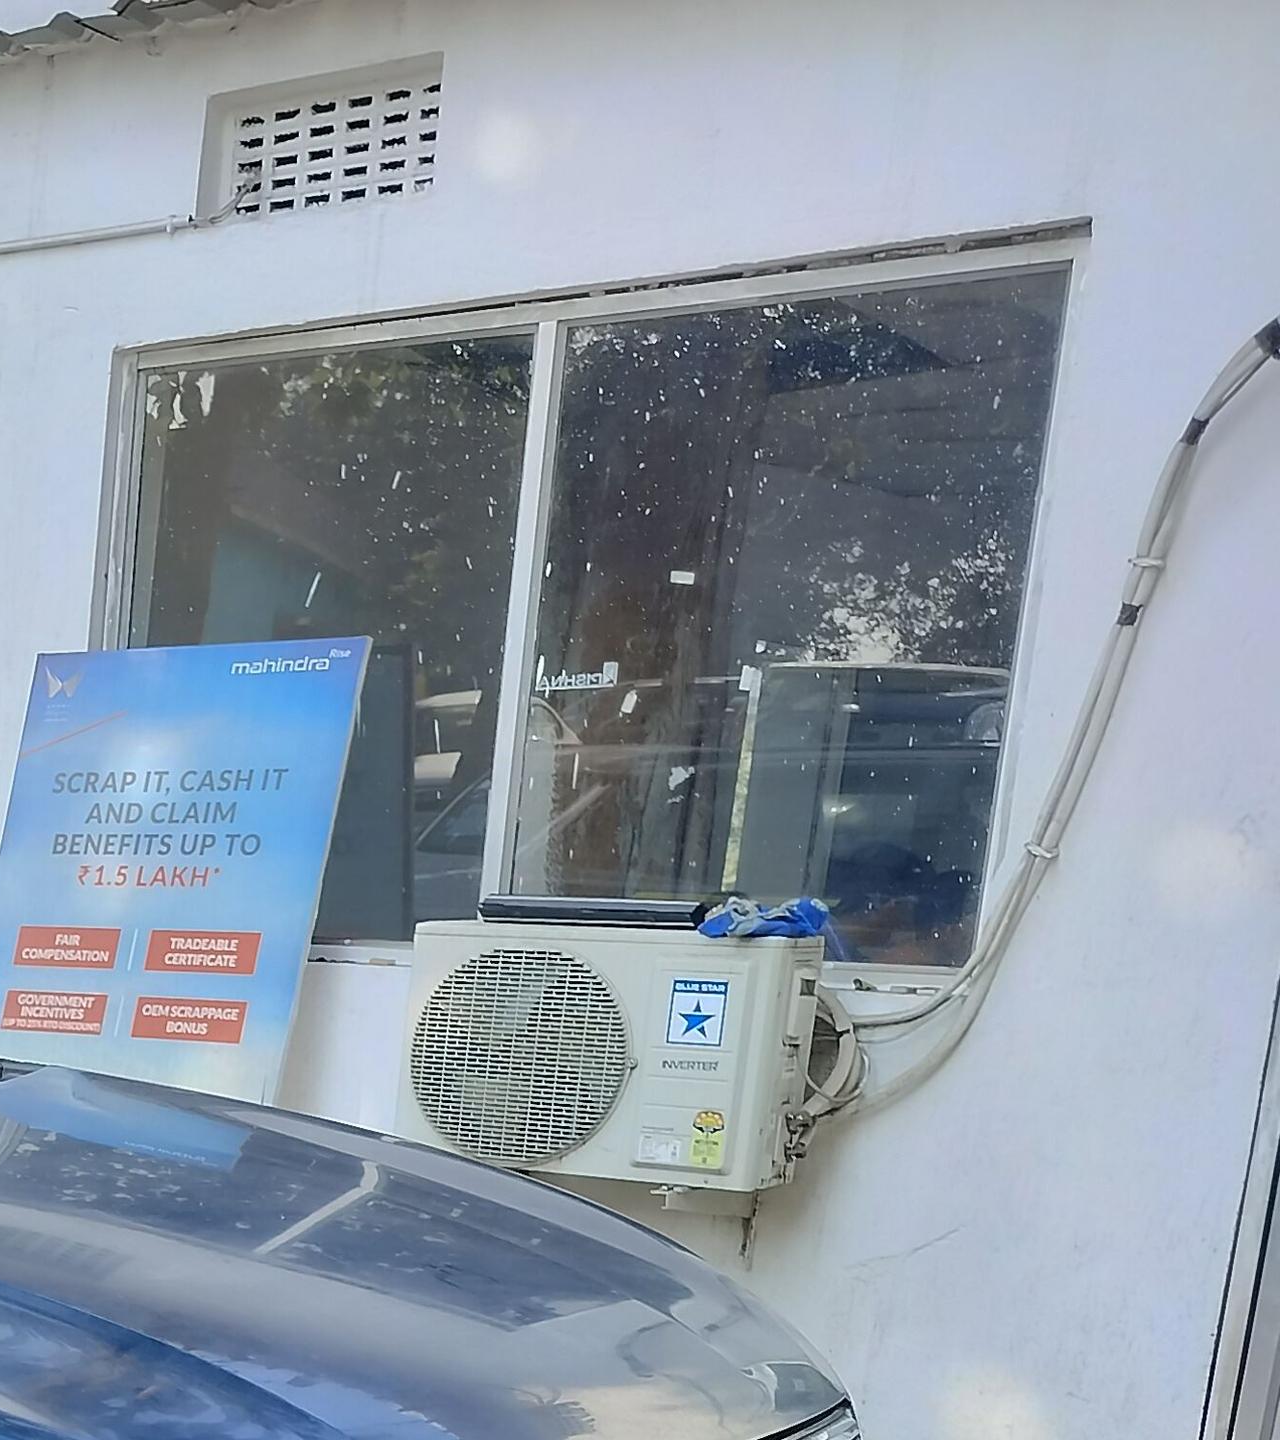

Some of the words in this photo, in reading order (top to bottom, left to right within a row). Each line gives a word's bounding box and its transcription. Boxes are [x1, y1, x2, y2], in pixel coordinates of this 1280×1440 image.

[229, 655, 329, 675] mahindra
[51, 771, 137, 794] SCRAP
[142, 770, 171, 796] IT,
[179, 768, 254, 793] CASH
[260, 768, 289, 791] IT
[84, 802, 144, 825] AND
[150, 801, 238, 824] CLAIM
[51, 833, 173, 856] BENEFITS
[179, 833, 217, 856] UP
[224, 833, 262, 856] TO
[77, 864, 129, 887] ₹1.5
[54, 933, 81, 947] FAIR
[169, 937, 240, 952] TRADEABLE
[21, 948, 110, 963] COMPENSATION
[163, 952, 238, 968] CERTIFICATE
[701, 983, 726, 993] STAR
[17, 993, 96, 1009] GOVERNMENT
[20, 1006, 85, 1020] INCENTIVES
[141, 1003, 170, 1017] OEM
[170, 1004, 240, 1021] SCRAPPAGE
[165, 1020, 208, 1036] BONUS
[661, 1059, 720, 1072] INVERTER
